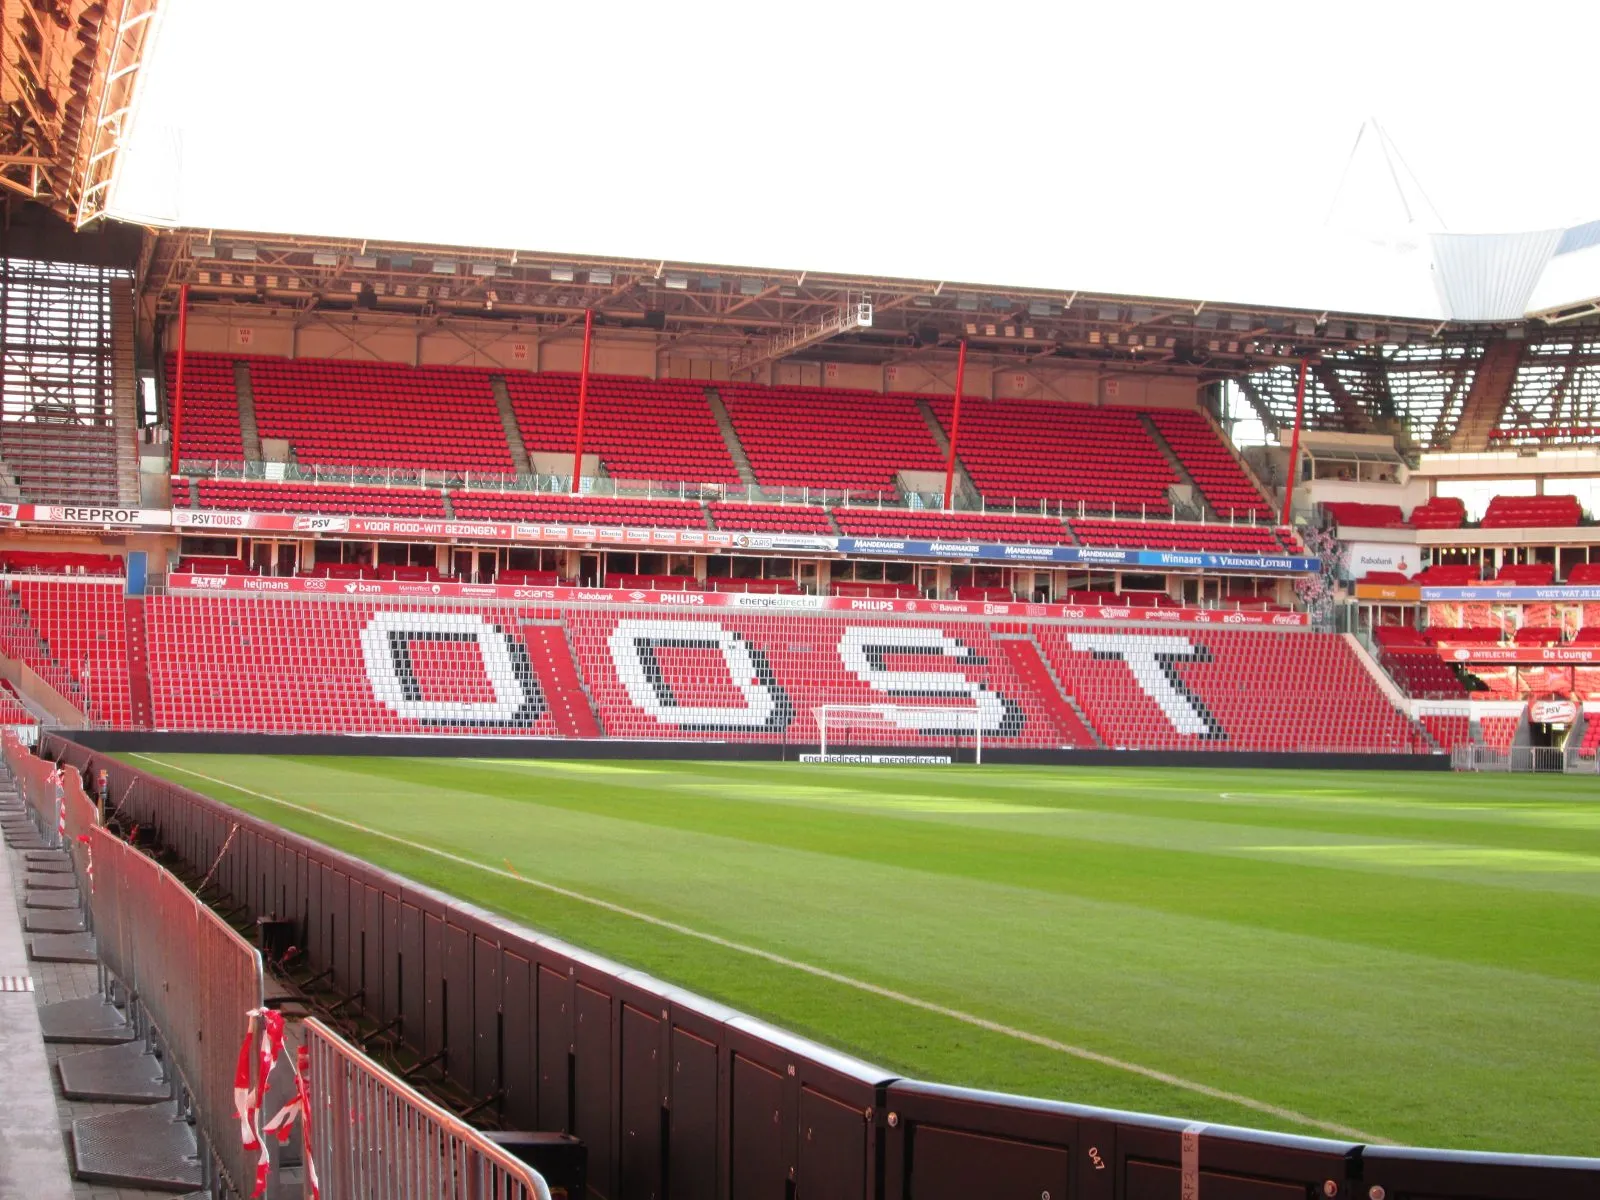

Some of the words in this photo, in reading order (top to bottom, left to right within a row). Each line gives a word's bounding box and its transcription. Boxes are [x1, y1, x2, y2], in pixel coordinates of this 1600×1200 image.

[64, 508, 140, 522] REPROF
[191, 513, 210, 525] PSV
[211, 514, 242, 526] TOURS
[311, 519, 330, 528] PSV
[364, 521, 391, 531] VOOR
[393, 522, 442, 534] ROOD-WIT
[445, 524, 498, 535] GEZONGEN
[1161, 554, 1202, 564] Winnaars
[190, 577, 227, 586] ELTEN
[359, 583, 381, 592] bam
[514, 589, 555, 599] axians
[577, 591, 614, 601] Rabobank
[660, 593, 704, 604] PHILIPS
[739, 597, 818, 607] energiedirect.nl
[851, 600, 894, 611] PHILIPS
[1543, 650, 1555, 658] De
[1558, 650, 1592, 660] Lounge
[359, 608, 1224, 742] OOST
